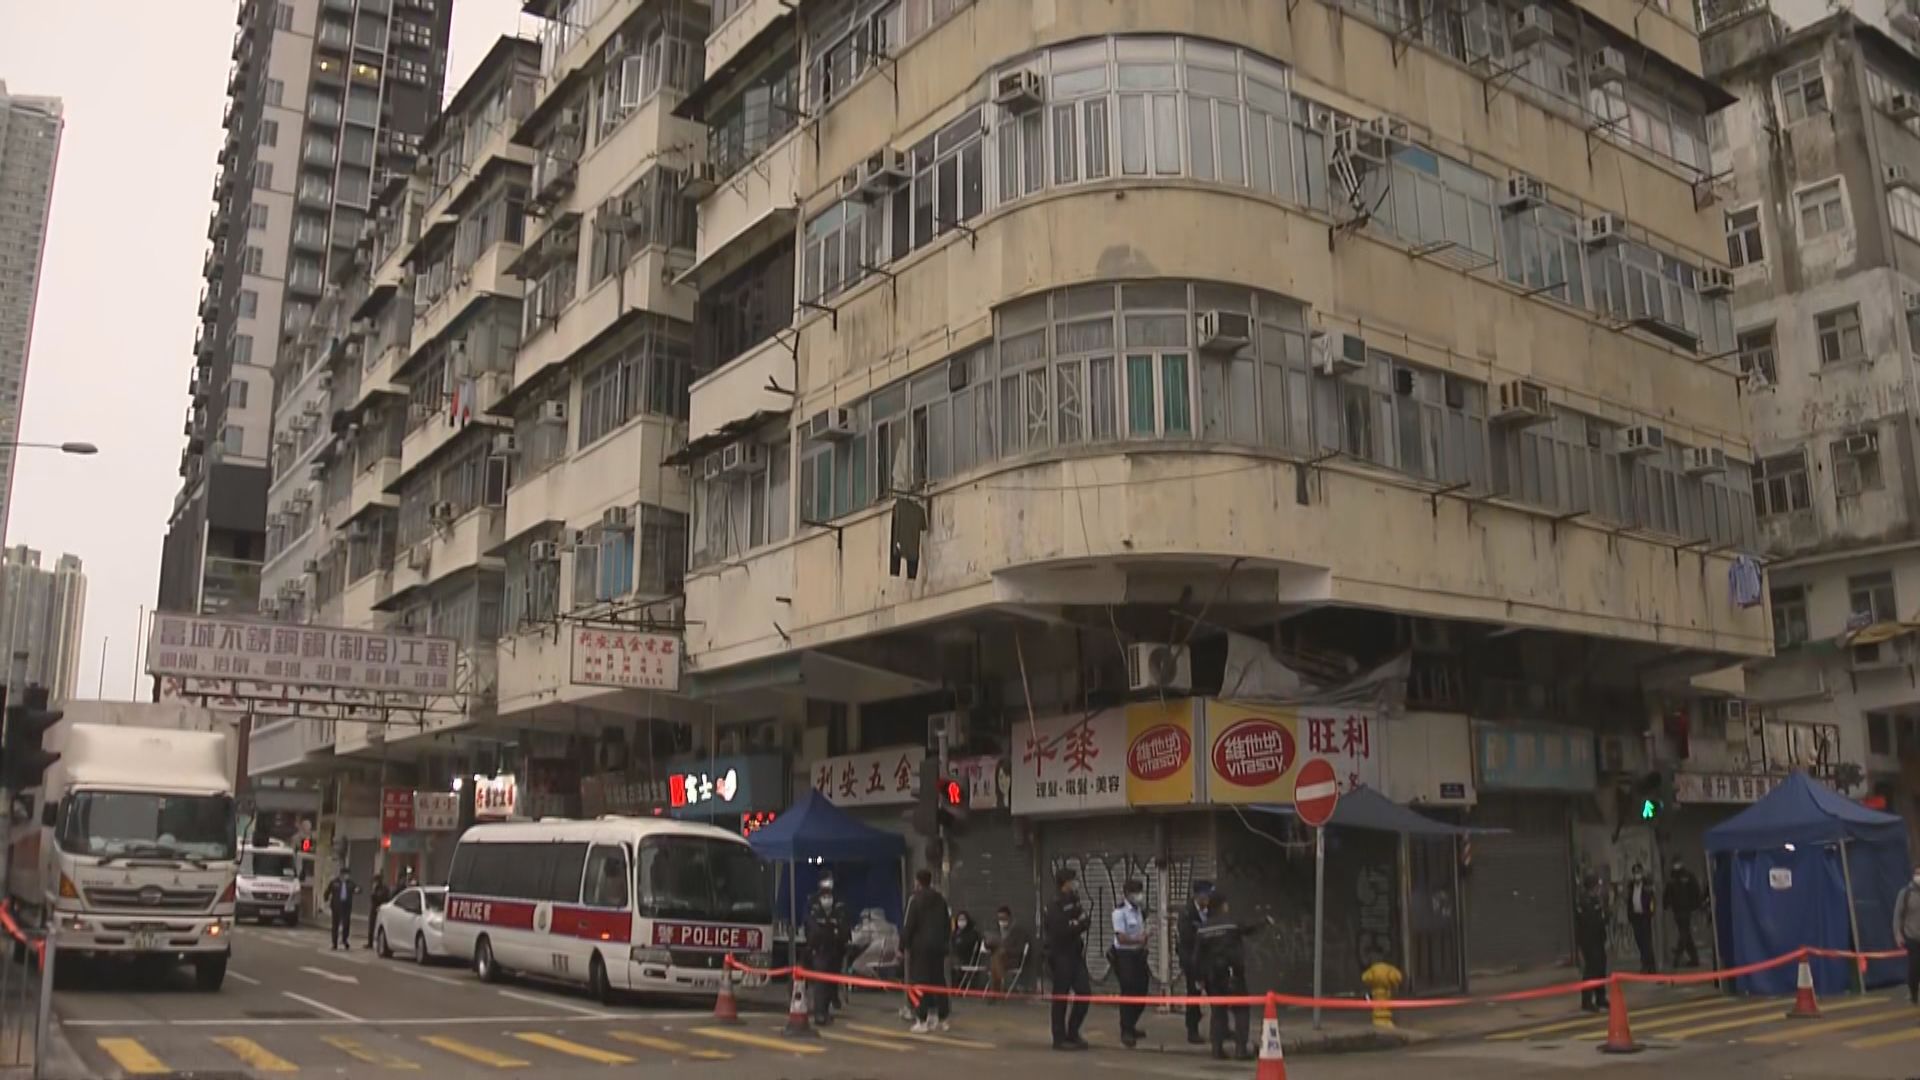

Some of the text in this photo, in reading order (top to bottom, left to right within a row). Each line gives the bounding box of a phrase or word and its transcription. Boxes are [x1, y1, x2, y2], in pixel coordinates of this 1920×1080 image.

[1135, 730, 1181, 761] 維他奶
[1224, 730, 1283, 761] 維他奶
[1308, 714, 1370, 759] 旺利
[817, 753, 911, 798] 利安五金
[1226, 754, 1284, 777] vitasoy
[459, 901, 484, 921] POLICE
[681, 925, 740, 947] POLICE
